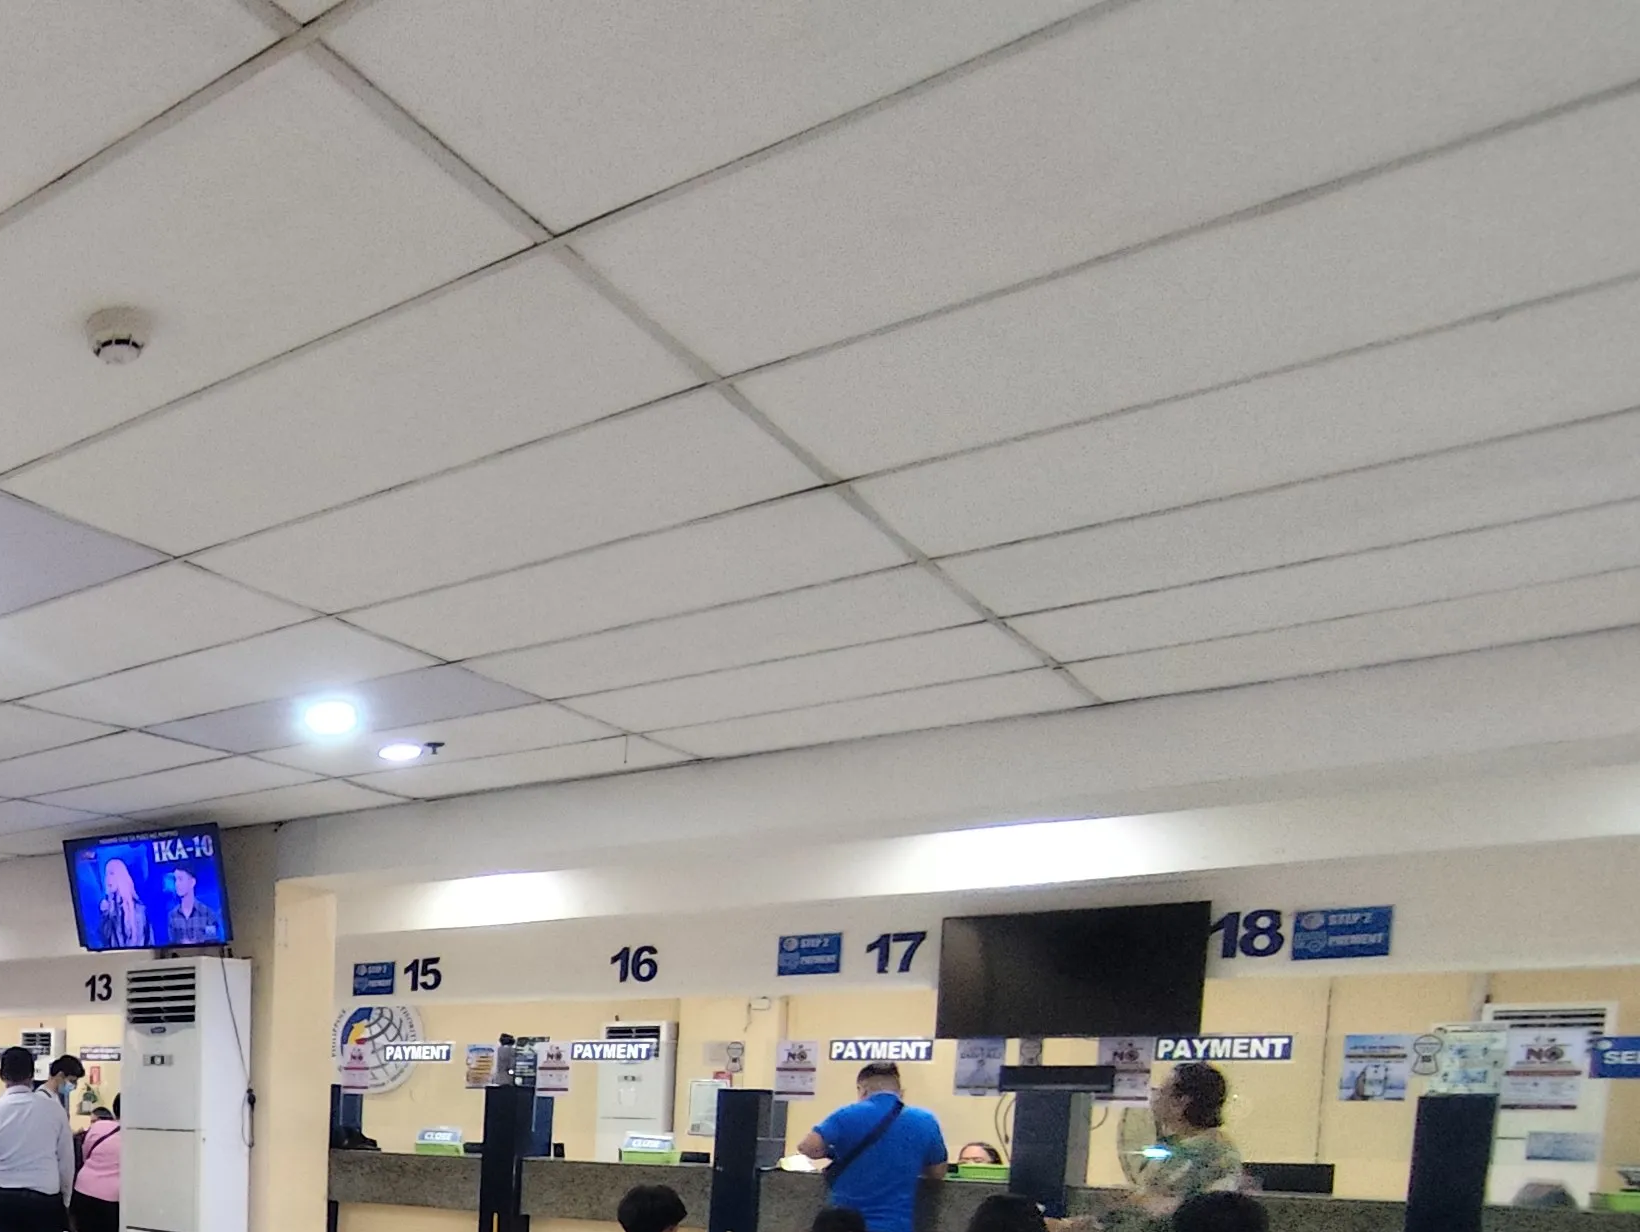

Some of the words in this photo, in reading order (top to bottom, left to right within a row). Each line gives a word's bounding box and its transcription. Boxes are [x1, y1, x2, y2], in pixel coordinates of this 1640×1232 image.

[152, 834, 215, 862] IKA-10
[1210, 908, 1285, 959] 18
[866, 931, 928, 974] 17
[404, 957, 442, 991] 15
[610, 945, 658, 983] 16
[85, 974, 112, 1002] 13
[385, 1045, 450, 1061] PAYMENT
[573, 1043, 651, 1060] PAYMENT
[831, 1041, 932, 1060] PAYMENT
[1157, 1037, 1289, 1059] PAYMENT
[1603, 1050, 1640, 1065] SE
[424, 1130, 453, 1142] CLOSE
[631, 1138, 661, 1149] CLOSE
